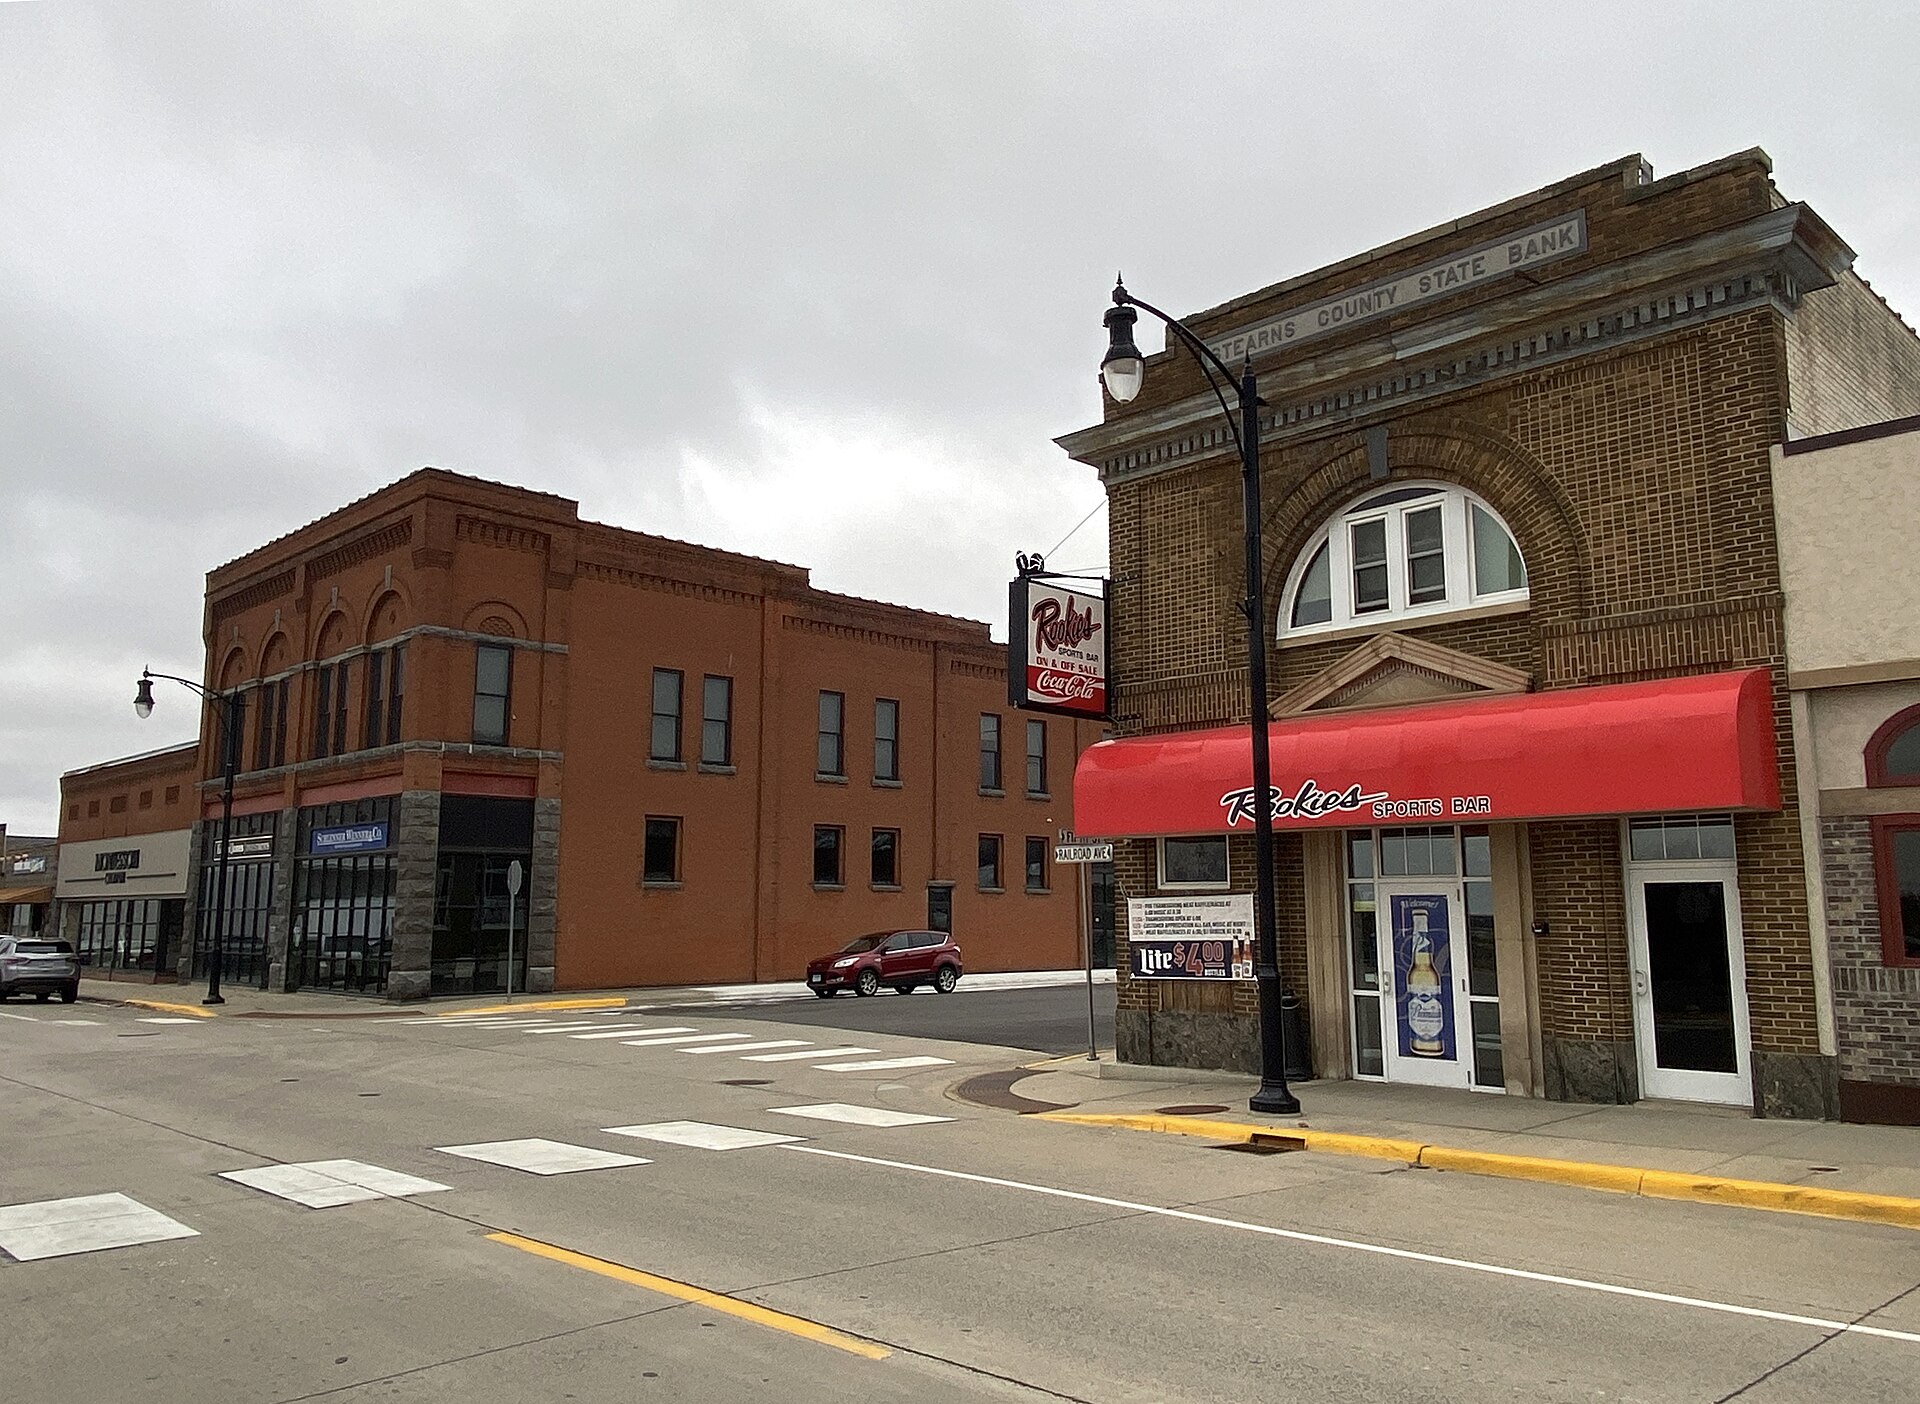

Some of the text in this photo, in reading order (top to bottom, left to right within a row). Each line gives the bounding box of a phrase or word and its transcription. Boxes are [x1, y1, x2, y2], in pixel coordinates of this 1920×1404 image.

[1212, 225, 1574, 361] STEARNS COUNTY STATE BANK
[1032, 594, 1102, 654] Rookies
[1036, 656, 1098, 675] ON & OFF SALE
[1059, 647, 1099, 663] SPORTS BAR
[1037, 669, 1094, 699] Coca-Cola
[1372, 796, 1491, 818] SPORTS BAR
[1058, 846, 1107, 861] RAILROAD AVE
[1140, 948, 1173, 975] Lite
